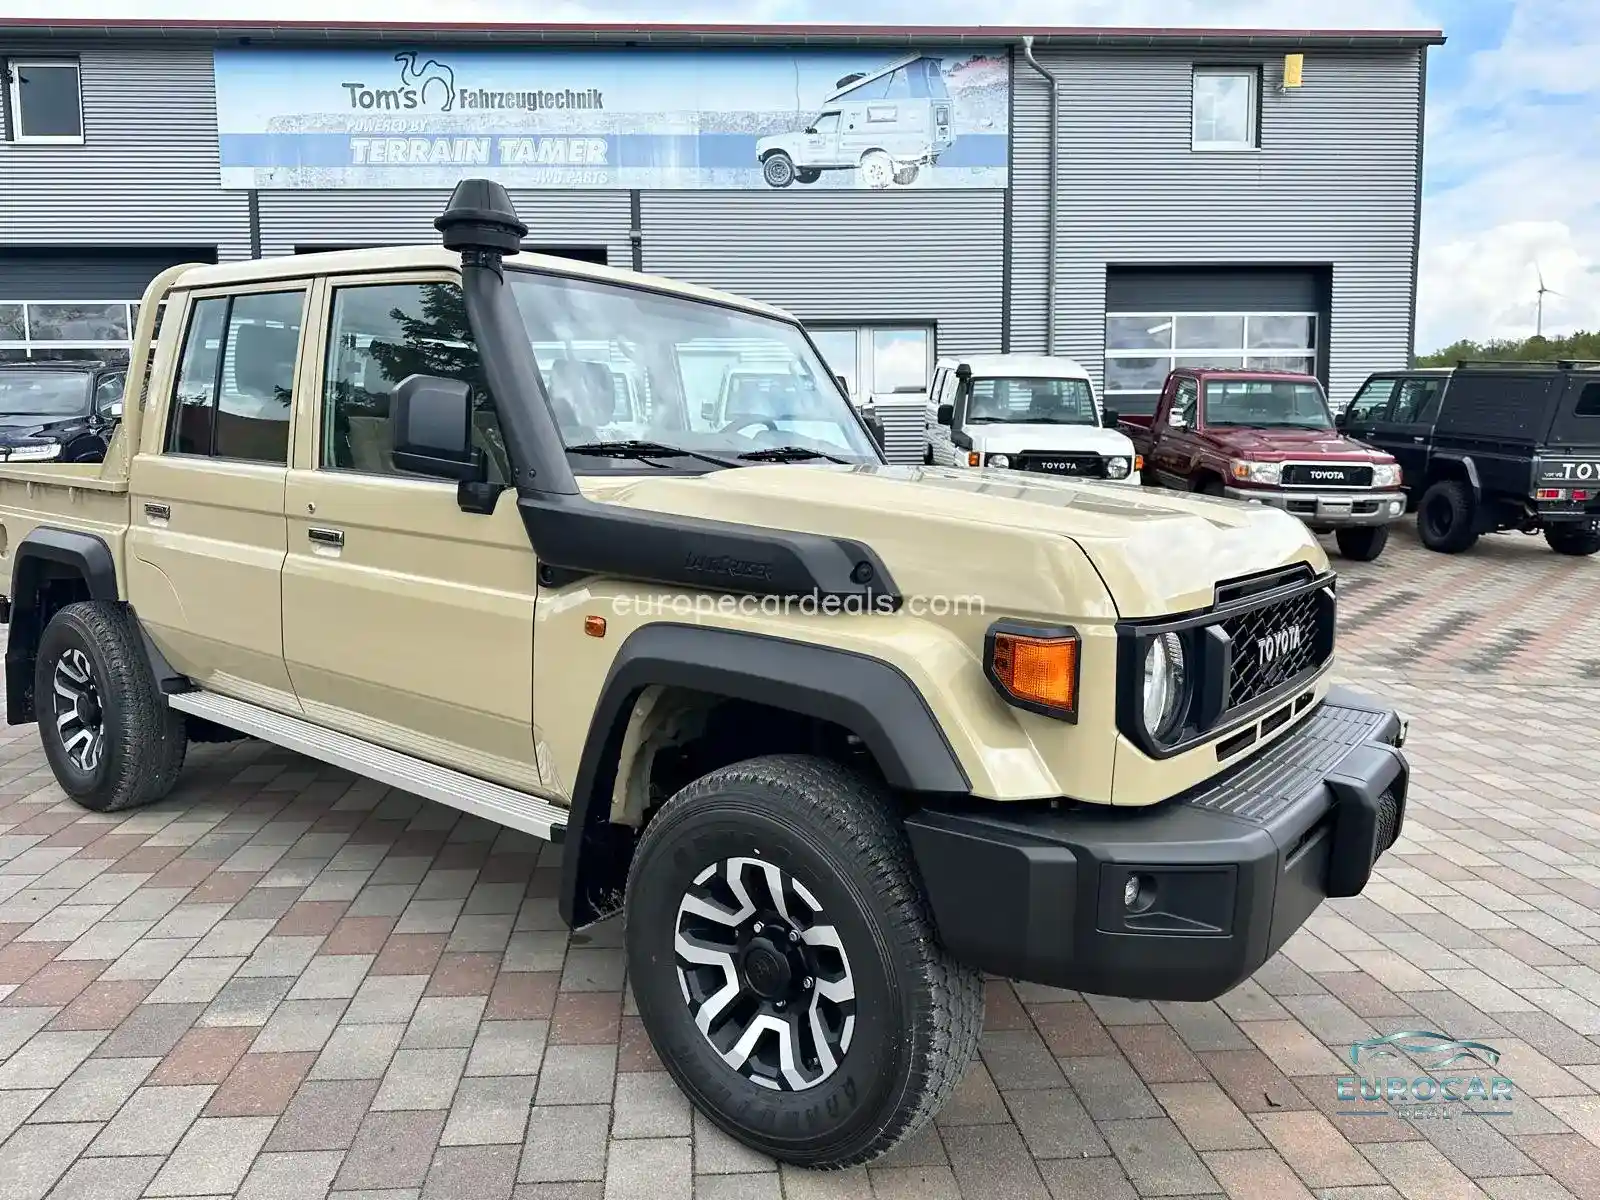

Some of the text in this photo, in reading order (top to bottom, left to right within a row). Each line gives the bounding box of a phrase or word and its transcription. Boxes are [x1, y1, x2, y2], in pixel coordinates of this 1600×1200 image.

[341, 82, 604, 112] Tom's Fahrzeugtechnik
[351, 137, 609, 165] TERRAIN TAMER
[1041, 461, 1077, 470] TOYOTA
[1310, 470, 1345, 479] TOYOTA
[1257, 624, 1301, 665] TOYOTA
